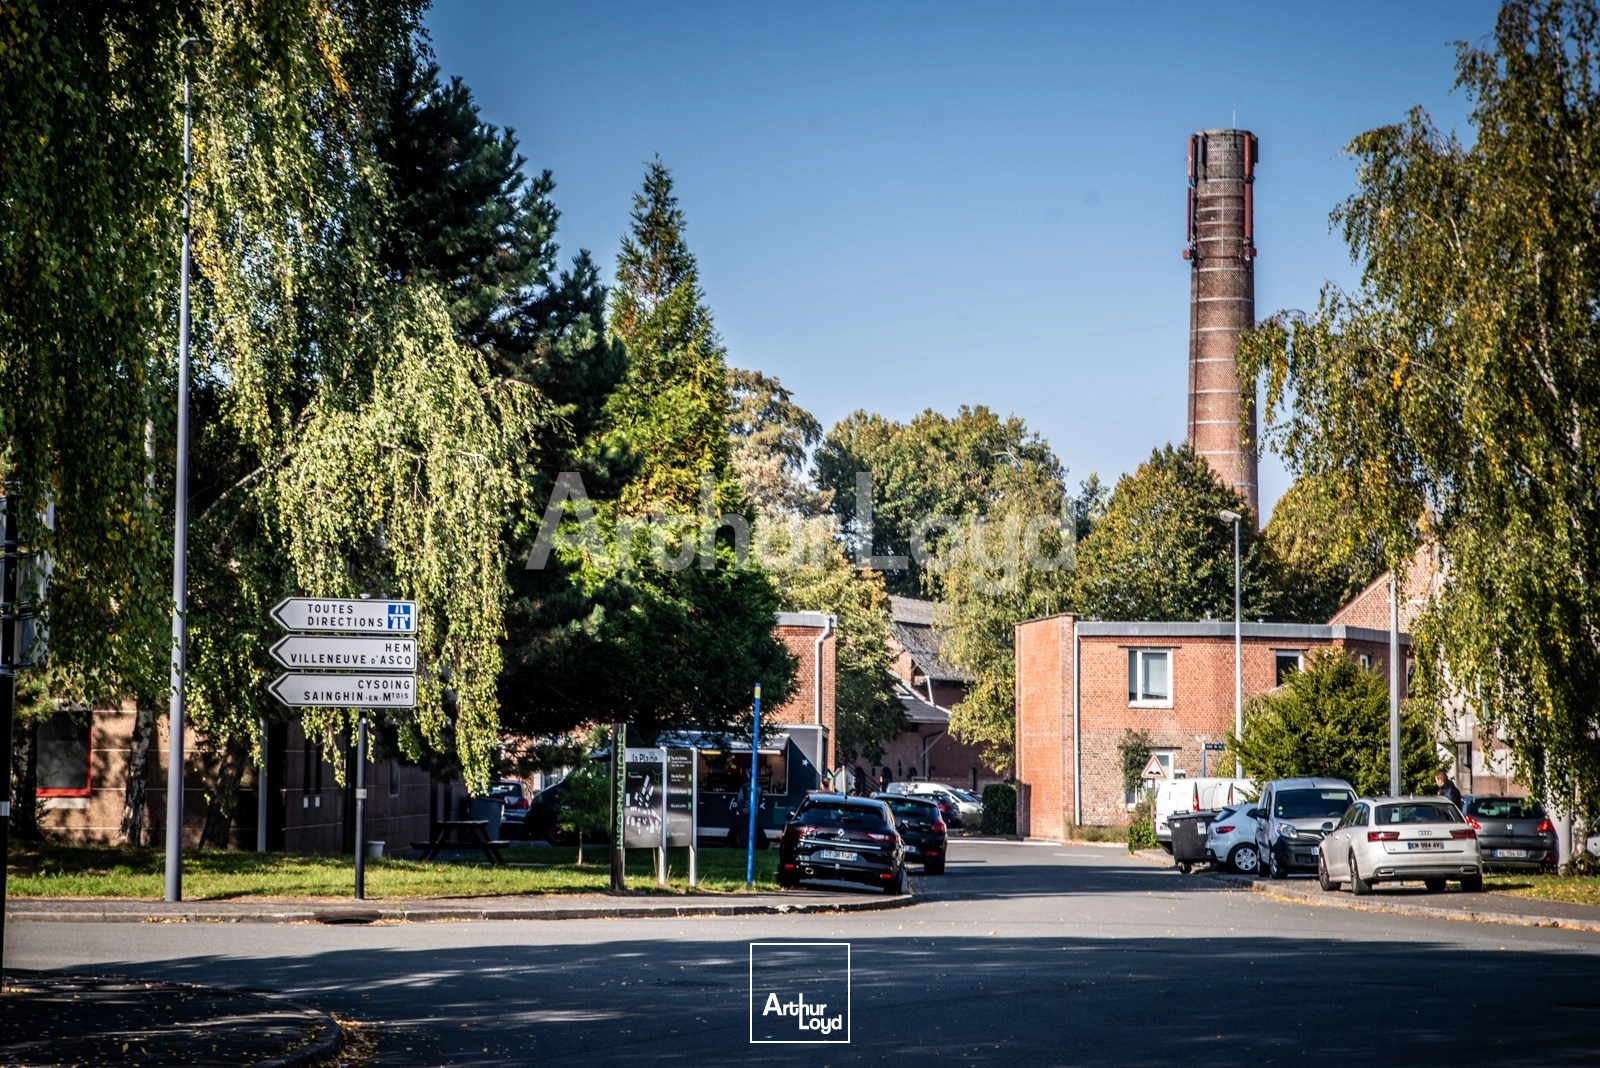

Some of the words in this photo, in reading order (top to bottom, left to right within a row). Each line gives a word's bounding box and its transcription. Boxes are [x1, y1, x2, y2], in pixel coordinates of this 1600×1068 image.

[307, 603, 354, 614] TOUTES
[307, 616, 384, 628] DIRECTIONS
[385, 643, 411, 653] HEM
[290, 653, 367, 664] VILLENEUVE
[358, 680, 410, 689] CYSOING
[616, 733, 625, 850] INFORMATIONS
